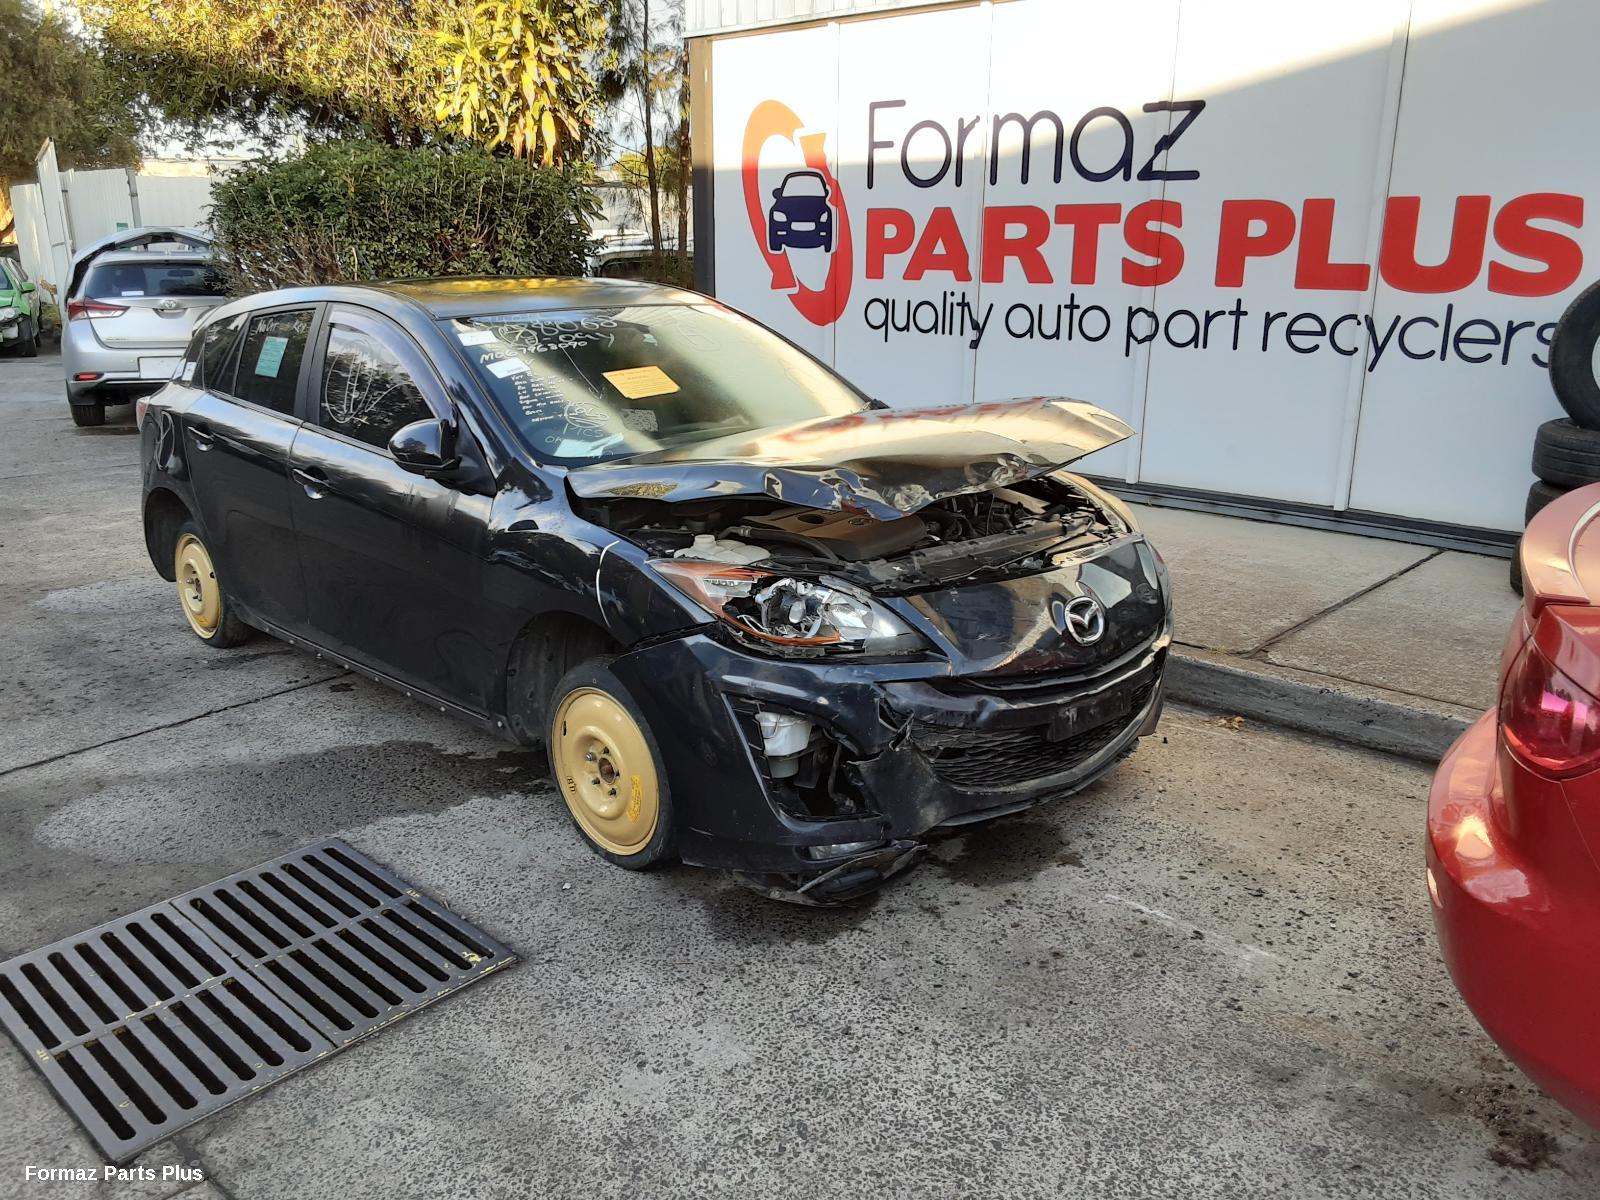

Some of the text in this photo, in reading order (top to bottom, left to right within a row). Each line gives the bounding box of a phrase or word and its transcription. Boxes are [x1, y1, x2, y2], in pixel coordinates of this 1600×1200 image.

[866, 99, 1206, 190] Formaz
[865, 192, 1584, 297] PARTS PLUS
[864, 290, 994, 349] quality
[1004, 293, 1111, 342] auto
[1125, 298, 1248, 357] part
